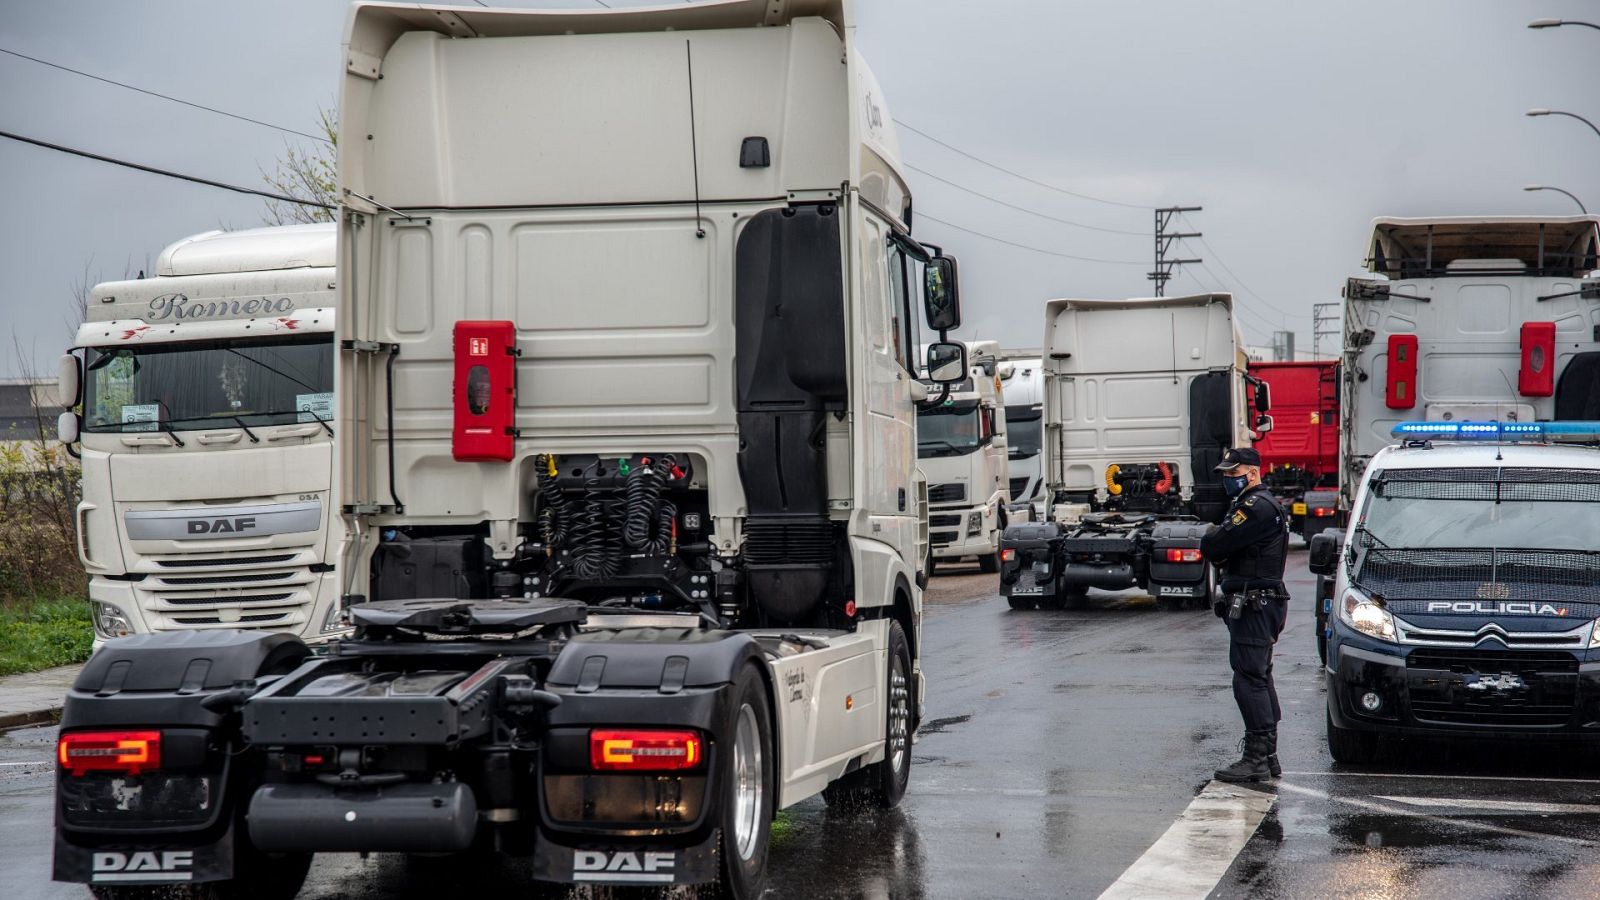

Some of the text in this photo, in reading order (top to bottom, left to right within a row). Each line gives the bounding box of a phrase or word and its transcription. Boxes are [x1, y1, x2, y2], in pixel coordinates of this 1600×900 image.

[148, 293, 294, 319] Romero
[187, 517, 256, 534] DAF
[1012, 586, 1044, 594] DAF
[1160, 586, 1193, 594] DAF
[92, 851, 193, 871] DAF
[573, 851, 675, 871] DAF
